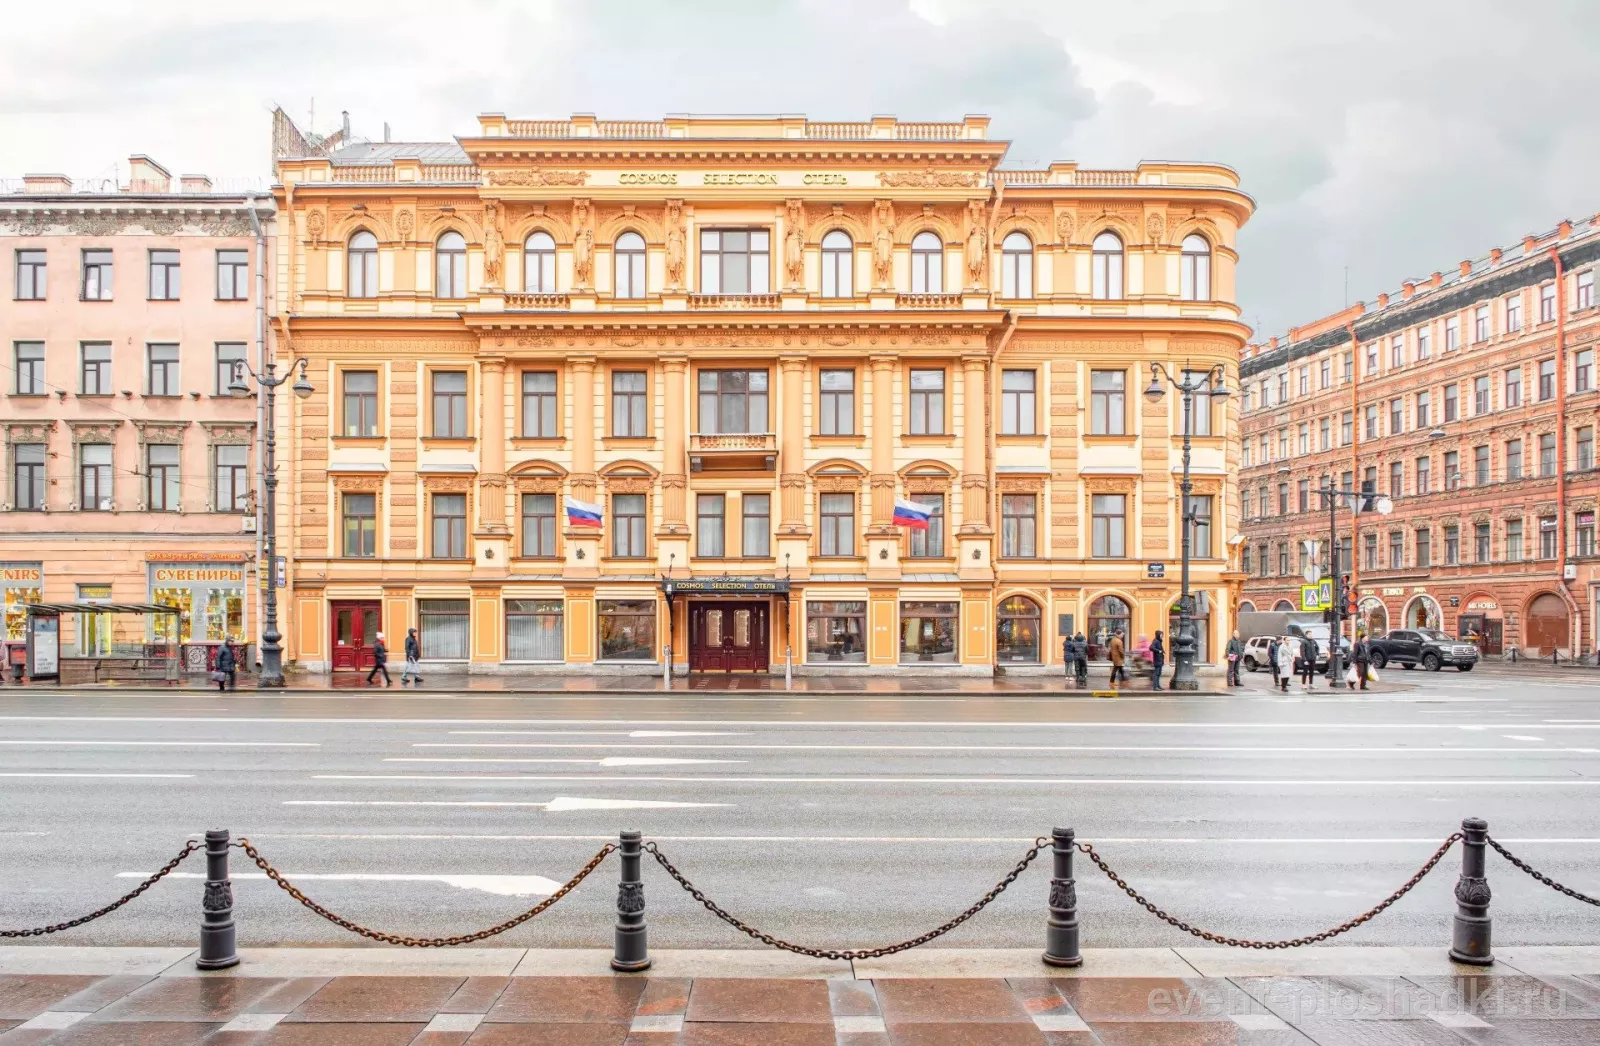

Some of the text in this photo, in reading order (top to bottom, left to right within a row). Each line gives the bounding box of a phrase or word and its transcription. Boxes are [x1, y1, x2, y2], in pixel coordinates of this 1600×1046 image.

[618, 173, 849, 185] COSMOS SELECTION ОТЕЛЬ
[156, 569, 242, 581] СУВЕНИРЫ
